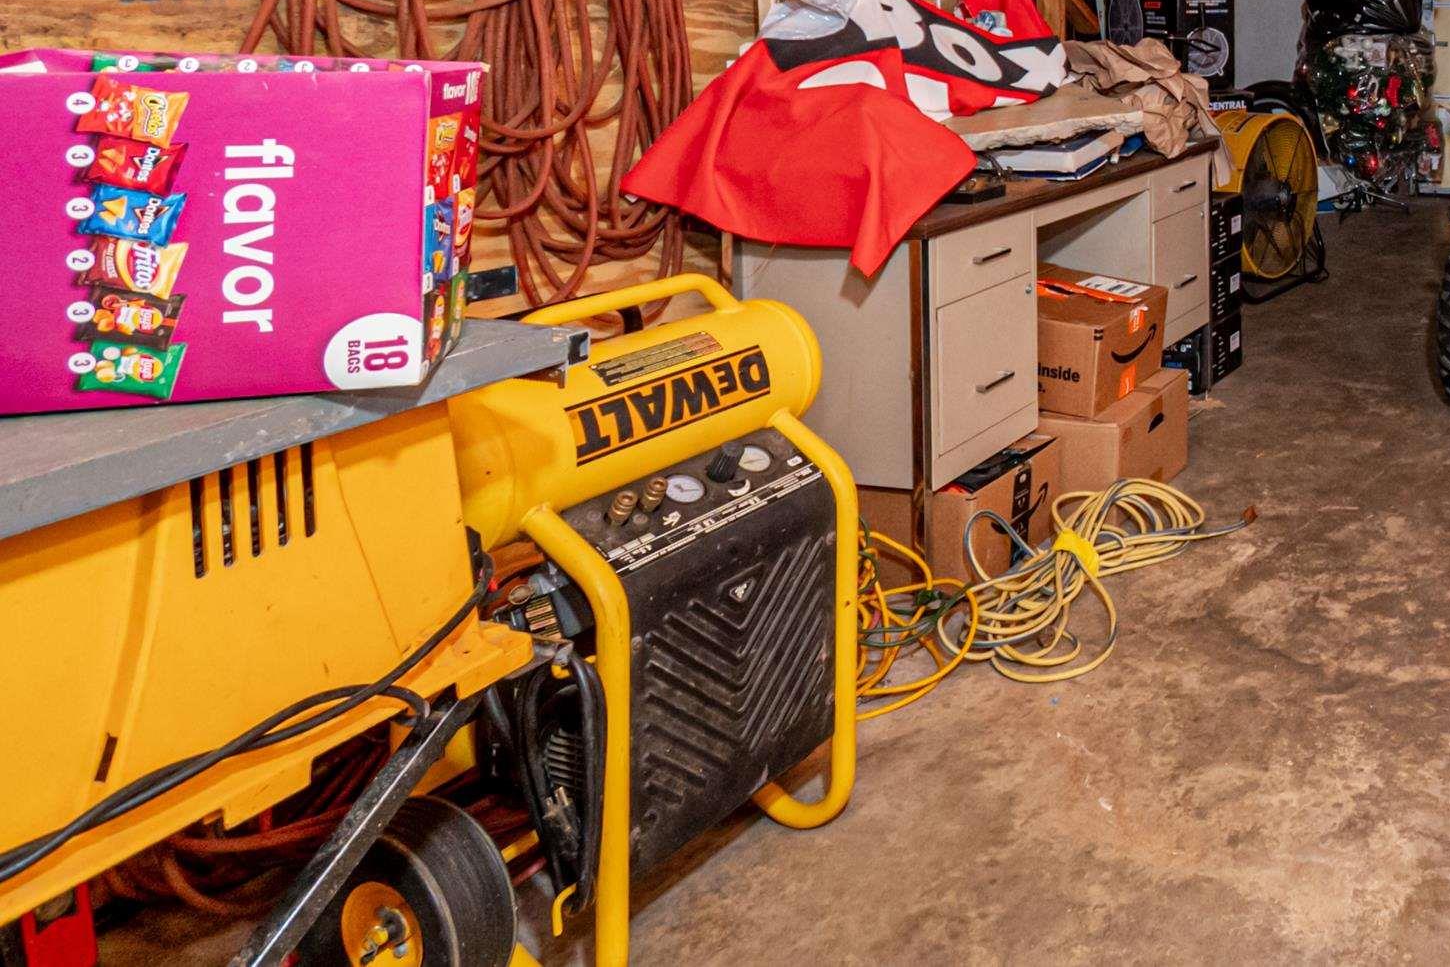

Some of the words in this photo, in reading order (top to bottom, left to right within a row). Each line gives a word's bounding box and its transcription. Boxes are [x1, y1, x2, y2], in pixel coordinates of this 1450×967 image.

[443, 82, 466, 101] flavor
[137, 146, 161, 183] Doritos
[138, 196, 162, 234] Doritos
[222, 138, 295, 333] flavor
[347, 339, 360, 375] BAGS
[363, 334, 409, 372] 18
